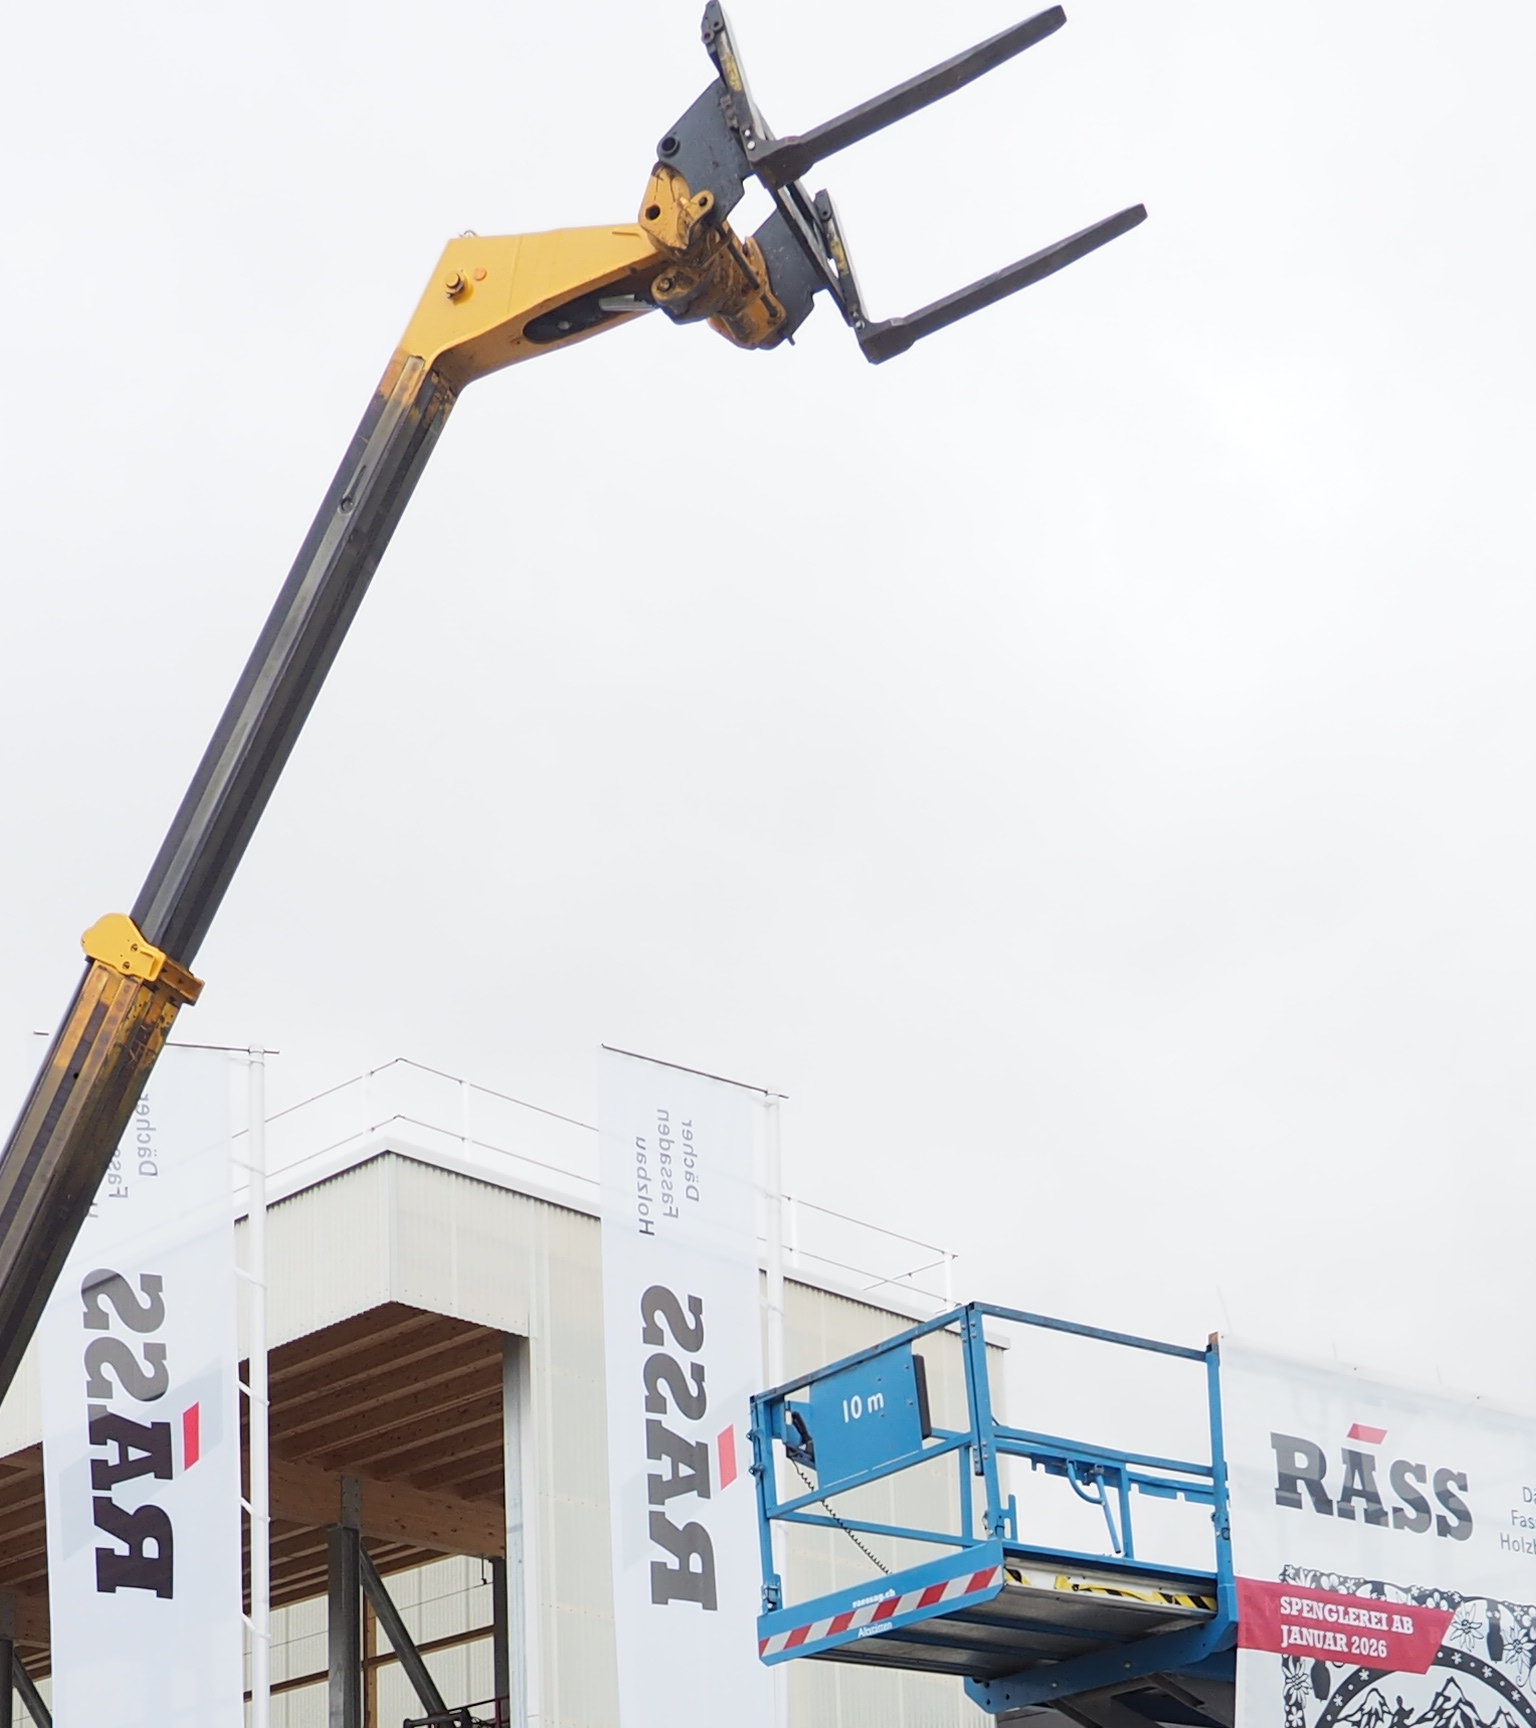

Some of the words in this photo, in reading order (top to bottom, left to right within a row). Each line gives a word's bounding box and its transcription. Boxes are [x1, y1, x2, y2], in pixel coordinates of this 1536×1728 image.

[842, 1395, 861, 1423] 10
[867, 1392, 885, 1413] m
[1280, 1596, 1388, 1632] SPENGLEREI
[1390, 1615, 1414, 1635] AB
[1280, 1625, 1348, 1653] JANUAR
[1350, 1638, 1388, 1659] 2026
